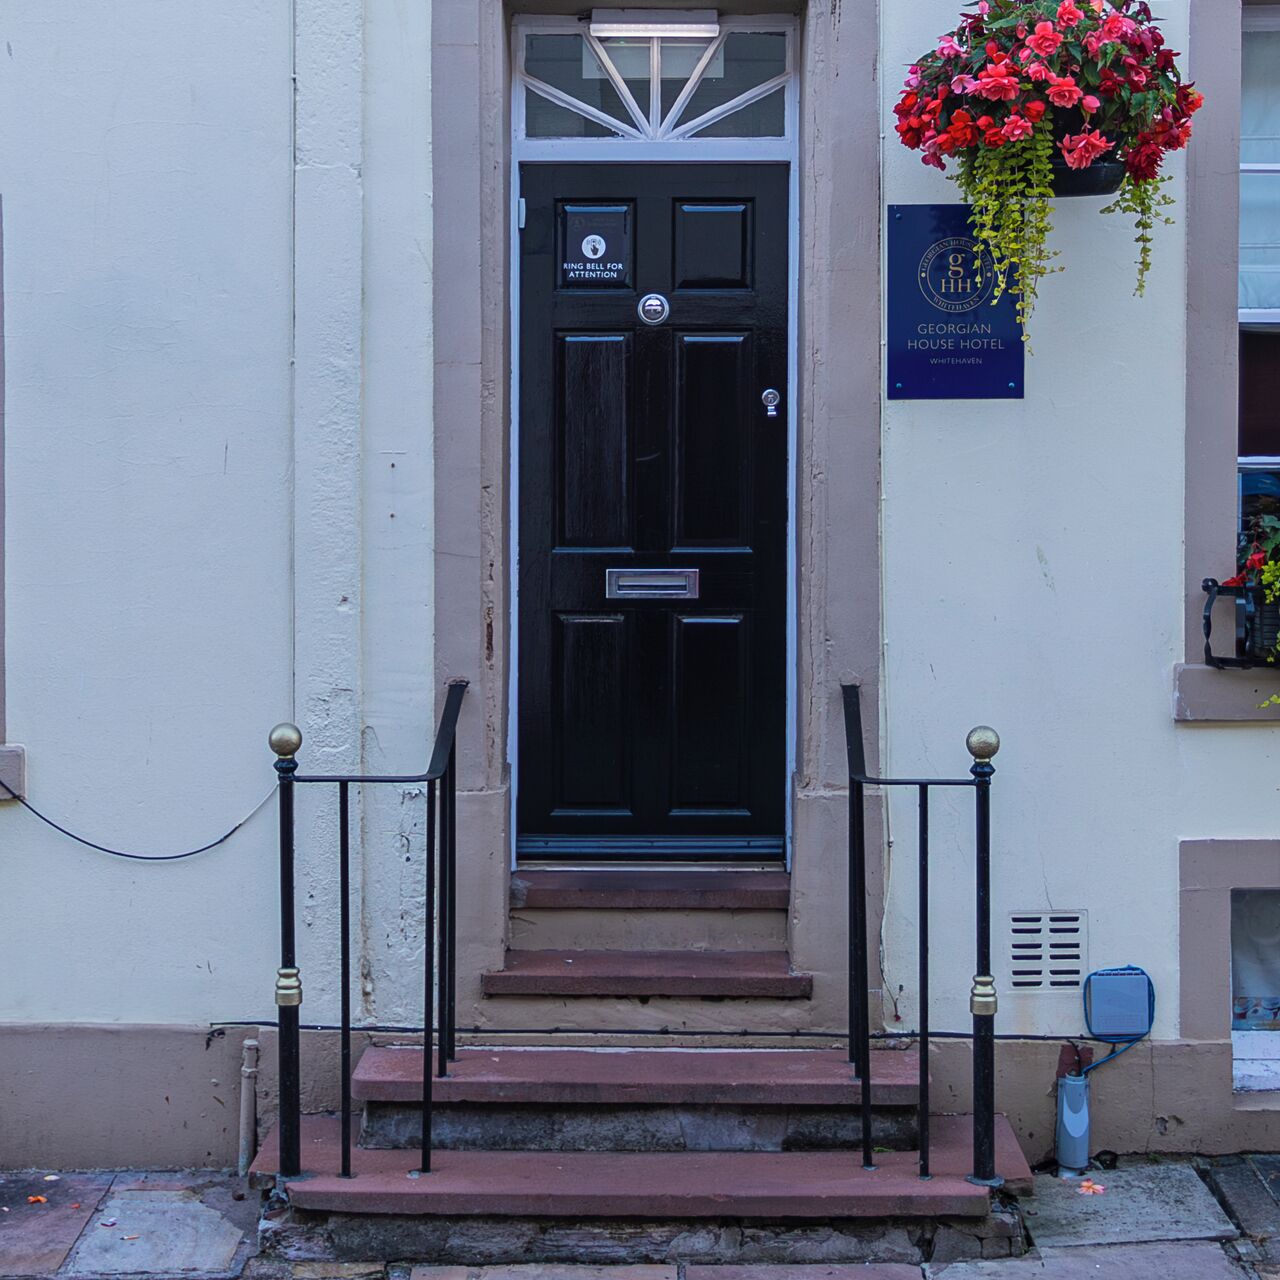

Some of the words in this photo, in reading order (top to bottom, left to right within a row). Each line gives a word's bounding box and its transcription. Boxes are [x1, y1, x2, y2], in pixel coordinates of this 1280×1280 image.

[563, 262, 584, 270] RING
[586, 262, 604, 270] BELL
[607, 262, 623, 270] FOR
[941, 278, 971, 293] HH
[917, 323, 991, 334] GEORGIAN
[907, 339, 955, 349] HOUSE
[960, 339, 1005, 349] HOTEL
[929, 357, 983, 365] WHITEHAVEN
